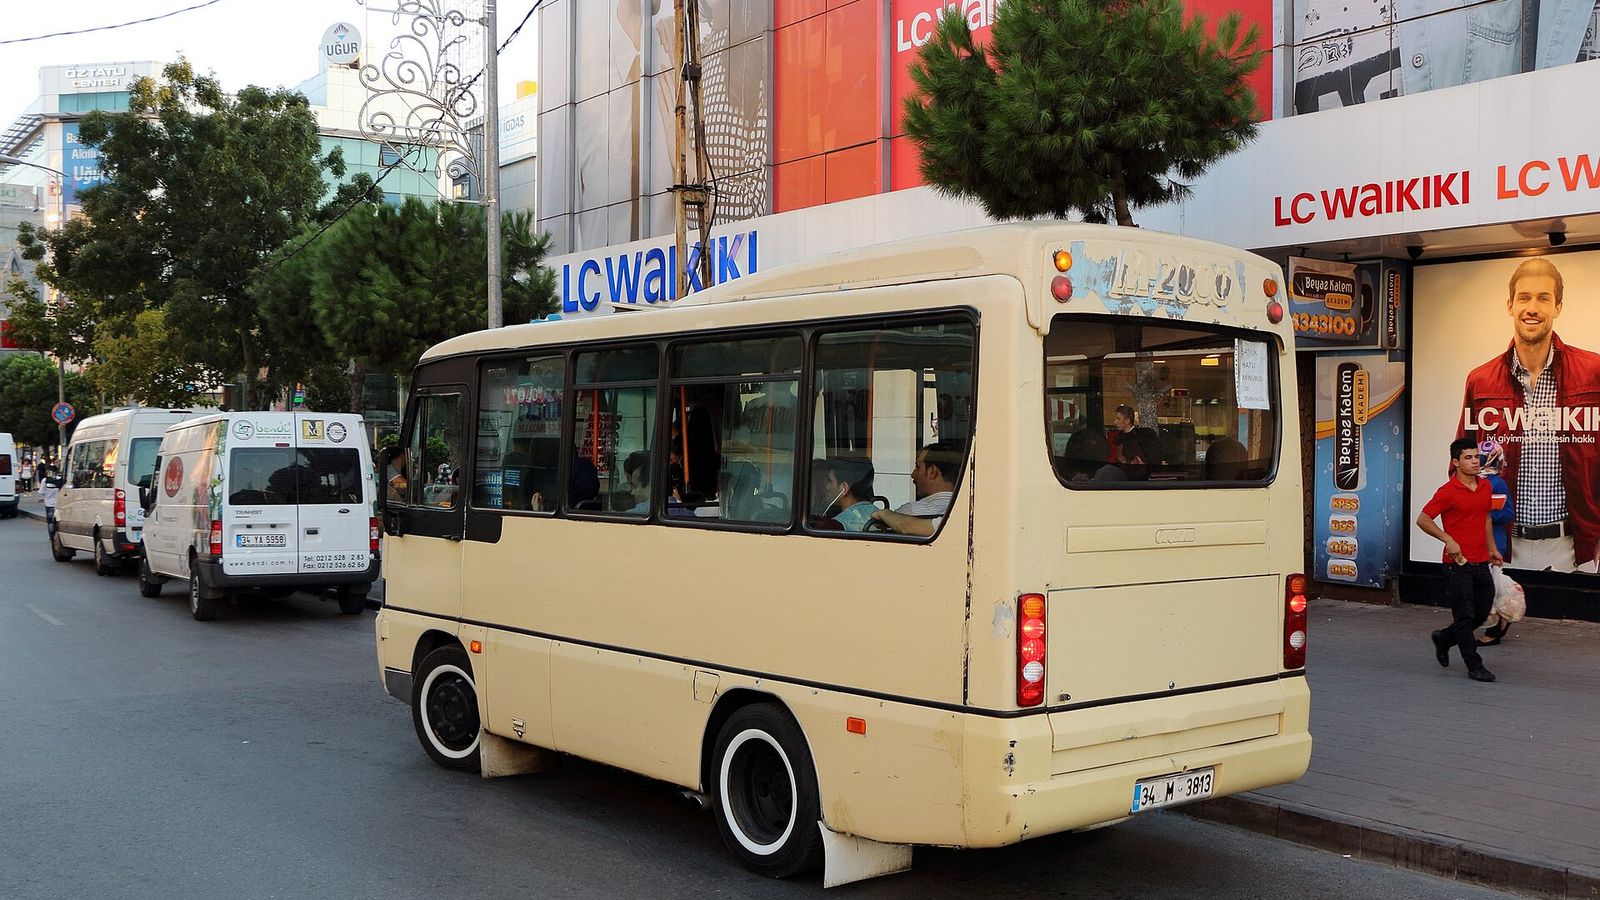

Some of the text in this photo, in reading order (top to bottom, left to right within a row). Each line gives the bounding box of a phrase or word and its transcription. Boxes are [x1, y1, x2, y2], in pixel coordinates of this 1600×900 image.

[326, 41, 358, 56] UĞUR
[897, 12, 932, 52] LC
[72, 79, 120, 88] CENTER
[1497, 160, 1550, 199] LC
[1274, 192, 1315, 226] LC
[563, 259, 601, 313] LC
[1305, 276, 1353, 293] Beyaz Kalem
[1339, 370, 1354, 466] Beyaz Kalem
[1464, 407, 1500, 431] LC
[242, 535, 284, 544] 34 YA 5958
[1141, 773, 1212, 806] 34 M 3813
